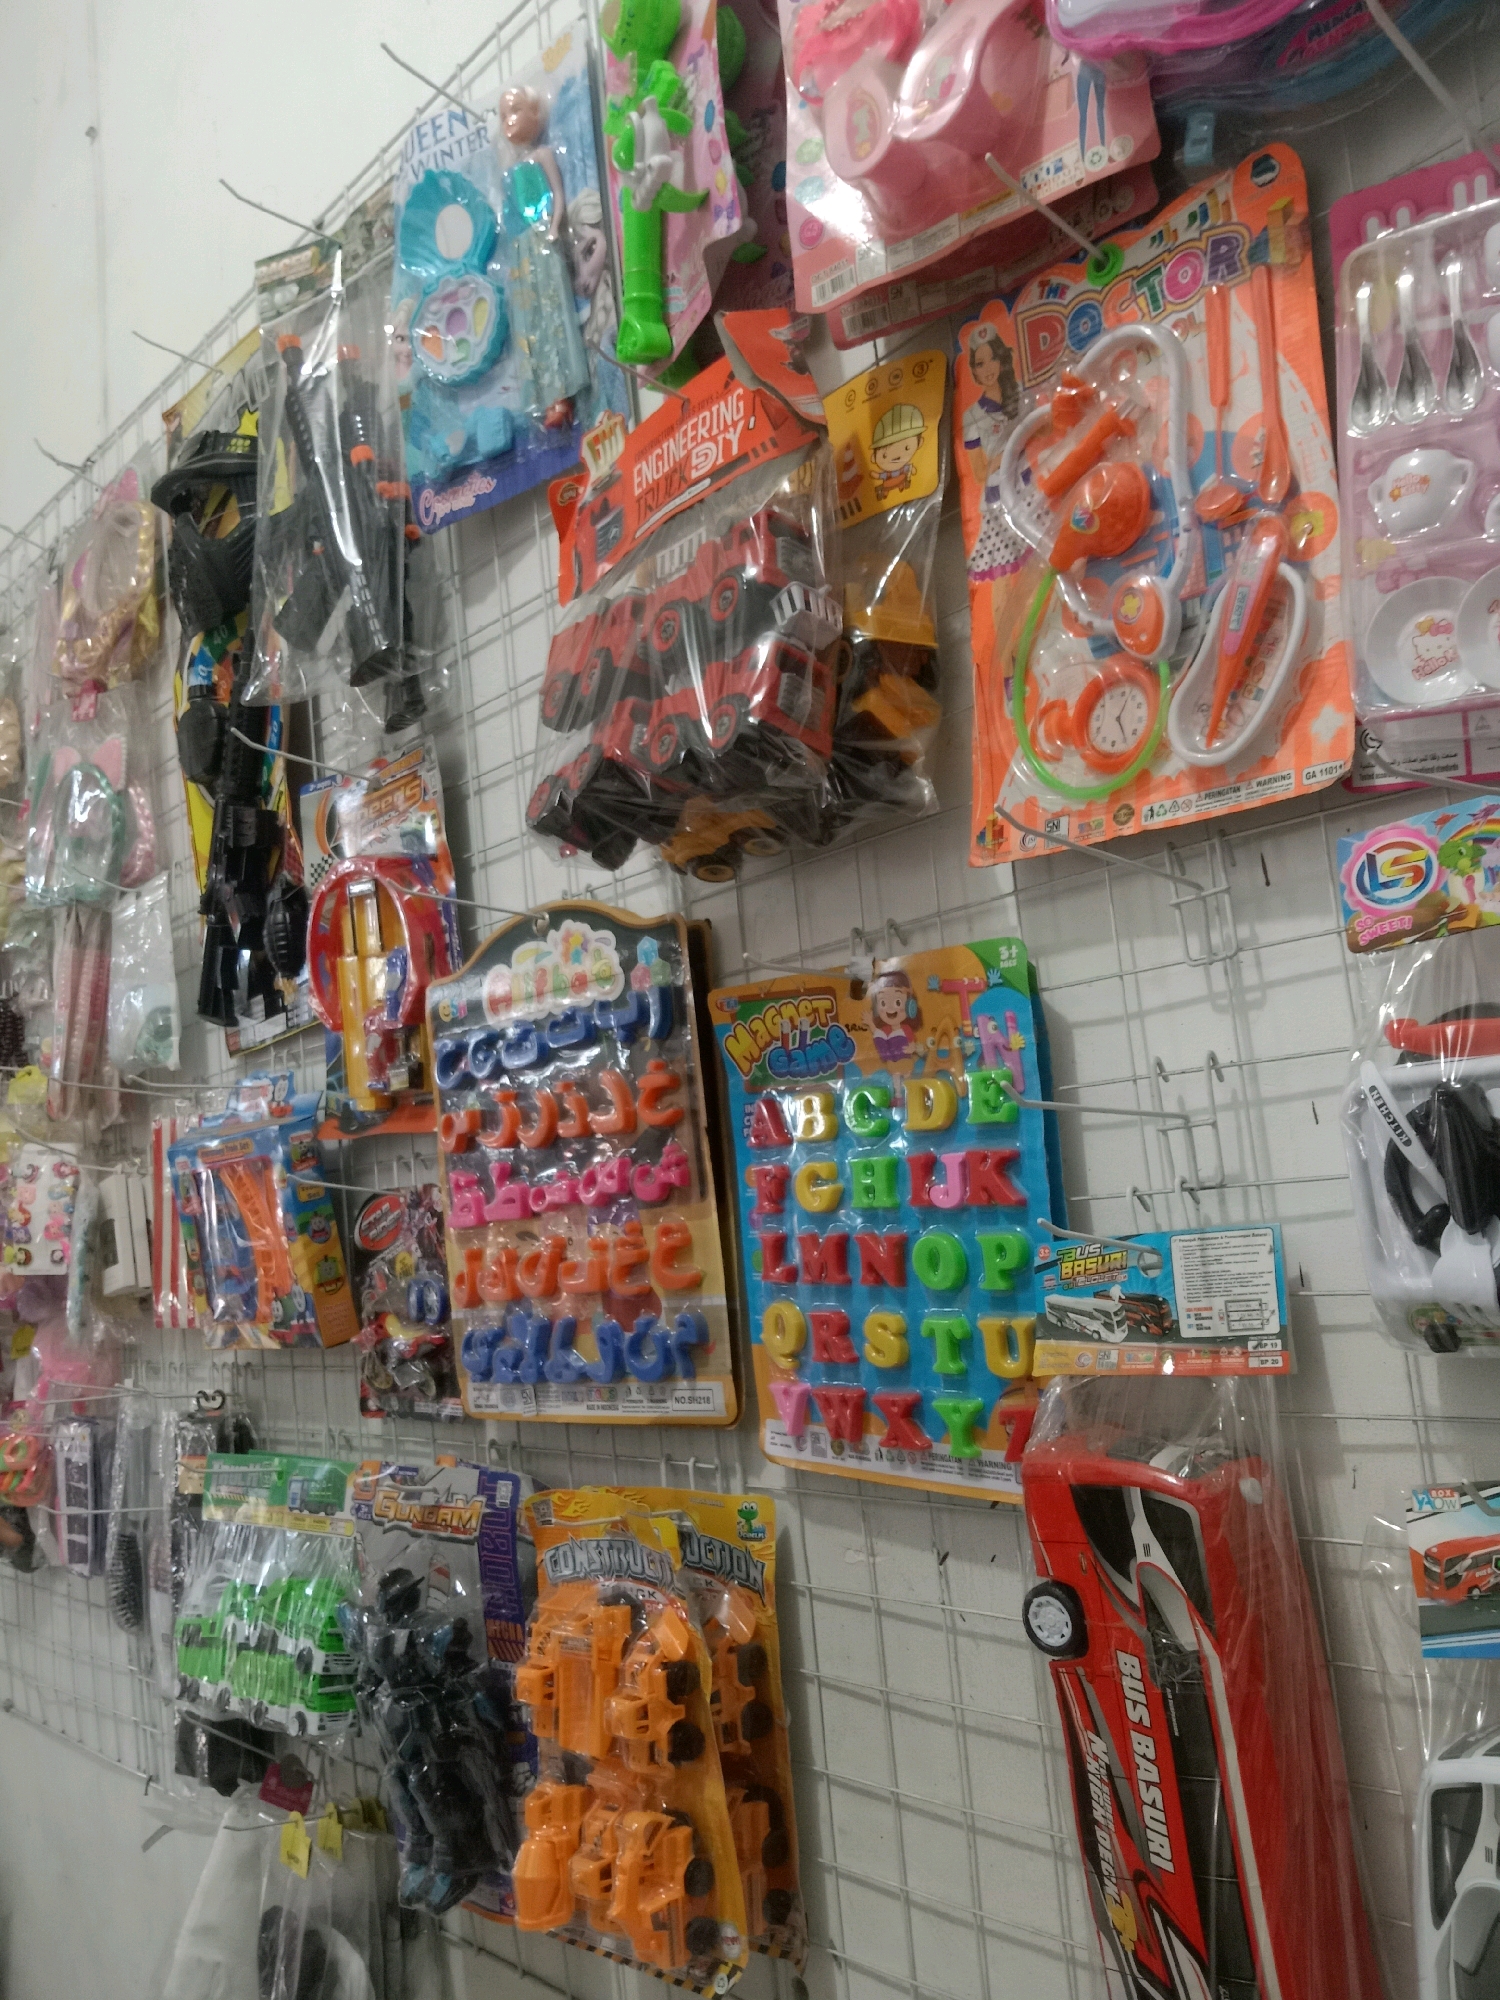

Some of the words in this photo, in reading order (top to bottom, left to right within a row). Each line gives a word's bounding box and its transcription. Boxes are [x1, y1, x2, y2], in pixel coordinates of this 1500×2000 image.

[402, 109, 469, 165] UEEN
[410, 126, 491, 180] WINTER
[1022, 230, 1248, 378] DOCTOR
[1038, 279, 1069, 300] THE
[633, 387, 744, 497] ENGINEERING
[691, 420, 745, 480] DIY
[1204, 785, 1241, 800] PERINGATAN
[1255, 772, 1292, 789] WARNING
[1305, 771, 1317, 780] GA
[1364, 848, 1430, 894] LS
[1354, 913, 1375, 932] SO
[1358, 914, 1414, 947] SWEET!
[999, 944, 1018, 961] 3+
[747, 1097, 793, 1147] A
[795, 1092, 839, 1142] B
[845, 1086, 891, 1138] C
[904, 1078, 958, 1131] D
[966, 1069, 1019, 1124] E
[1371, 1088, 1410, 1145] KITCHEN
[795, 1161, 844, 1213] G
[851, 1156, 899, 1209] H
[929, 1151, 968, 1209] J
[965, 1149, 1027, 1207] K
[759, 1232, 798, 1284] L
[797, 1232, 851, 1284] M
[854, 1232, 908, 1288] N
[912, 1231, 967, 1290] O
[976, 1231, 1032, 1291] P
[1039, 1247, 1051, 1259] 3+
[1057, 1243, 1103, 1262] BUS
[1060, 1250, 1128, 1281] BASURI
[760, 1300, 807, 1370] Q
[809, 1310, 859, 1364] R
[864, 1312, 910, 1369] S
[920, 1316, 971, 1375] T
[977, 1316, 1036, 1378] U
[768, 1381, 812, 1437] V
[811, 1385, 867, 1443] W
[872, 1392, 933, 1449] X
[932, 1398, 983, 1459] Y
[928, 1451, 963, 1465] PERINGATAN
[976, 1459, 1013, 1471] WARNING
[373, 1488, 485, 1530] GUNDAM
[1431, 1489, 1452, 1498] BOX
[1115, 1648, 1151, 1729] BUS
[1130, 1729, 1176, 1875] BASURI
[1094, 1824, 1124, 1908] DECK
